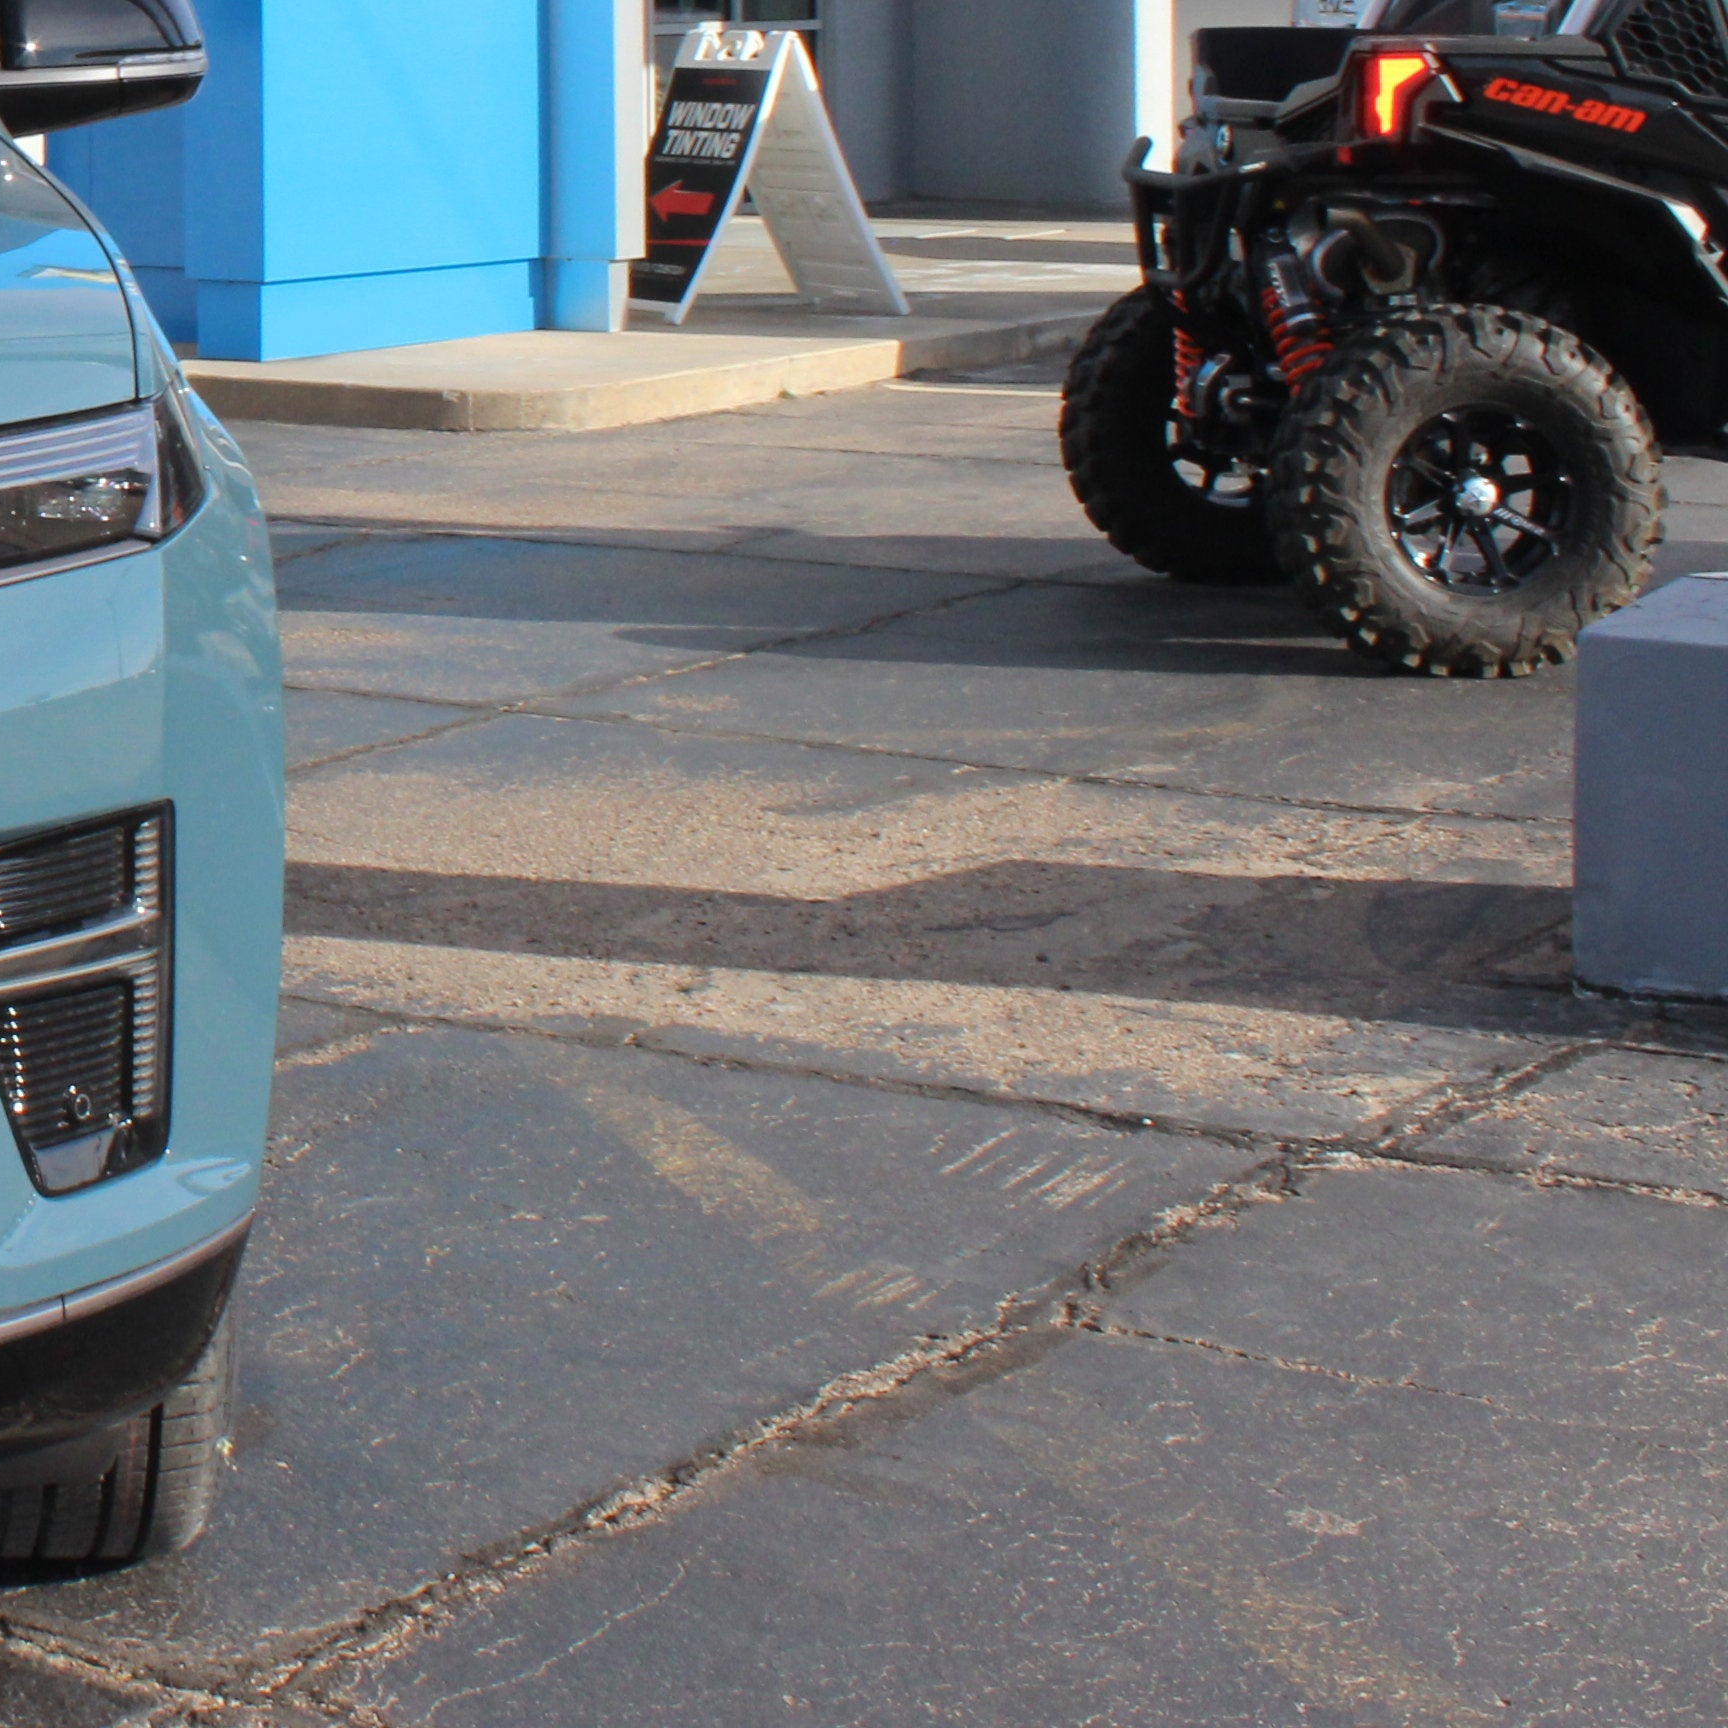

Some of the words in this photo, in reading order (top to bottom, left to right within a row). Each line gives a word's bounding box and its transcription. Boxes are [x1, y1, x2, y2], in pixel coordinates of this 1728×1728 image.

[667, 100, 756, 130] WINDOW
[1483, 77, 1648, 133] can-am
[662, 128, 741, 159] TINTING
